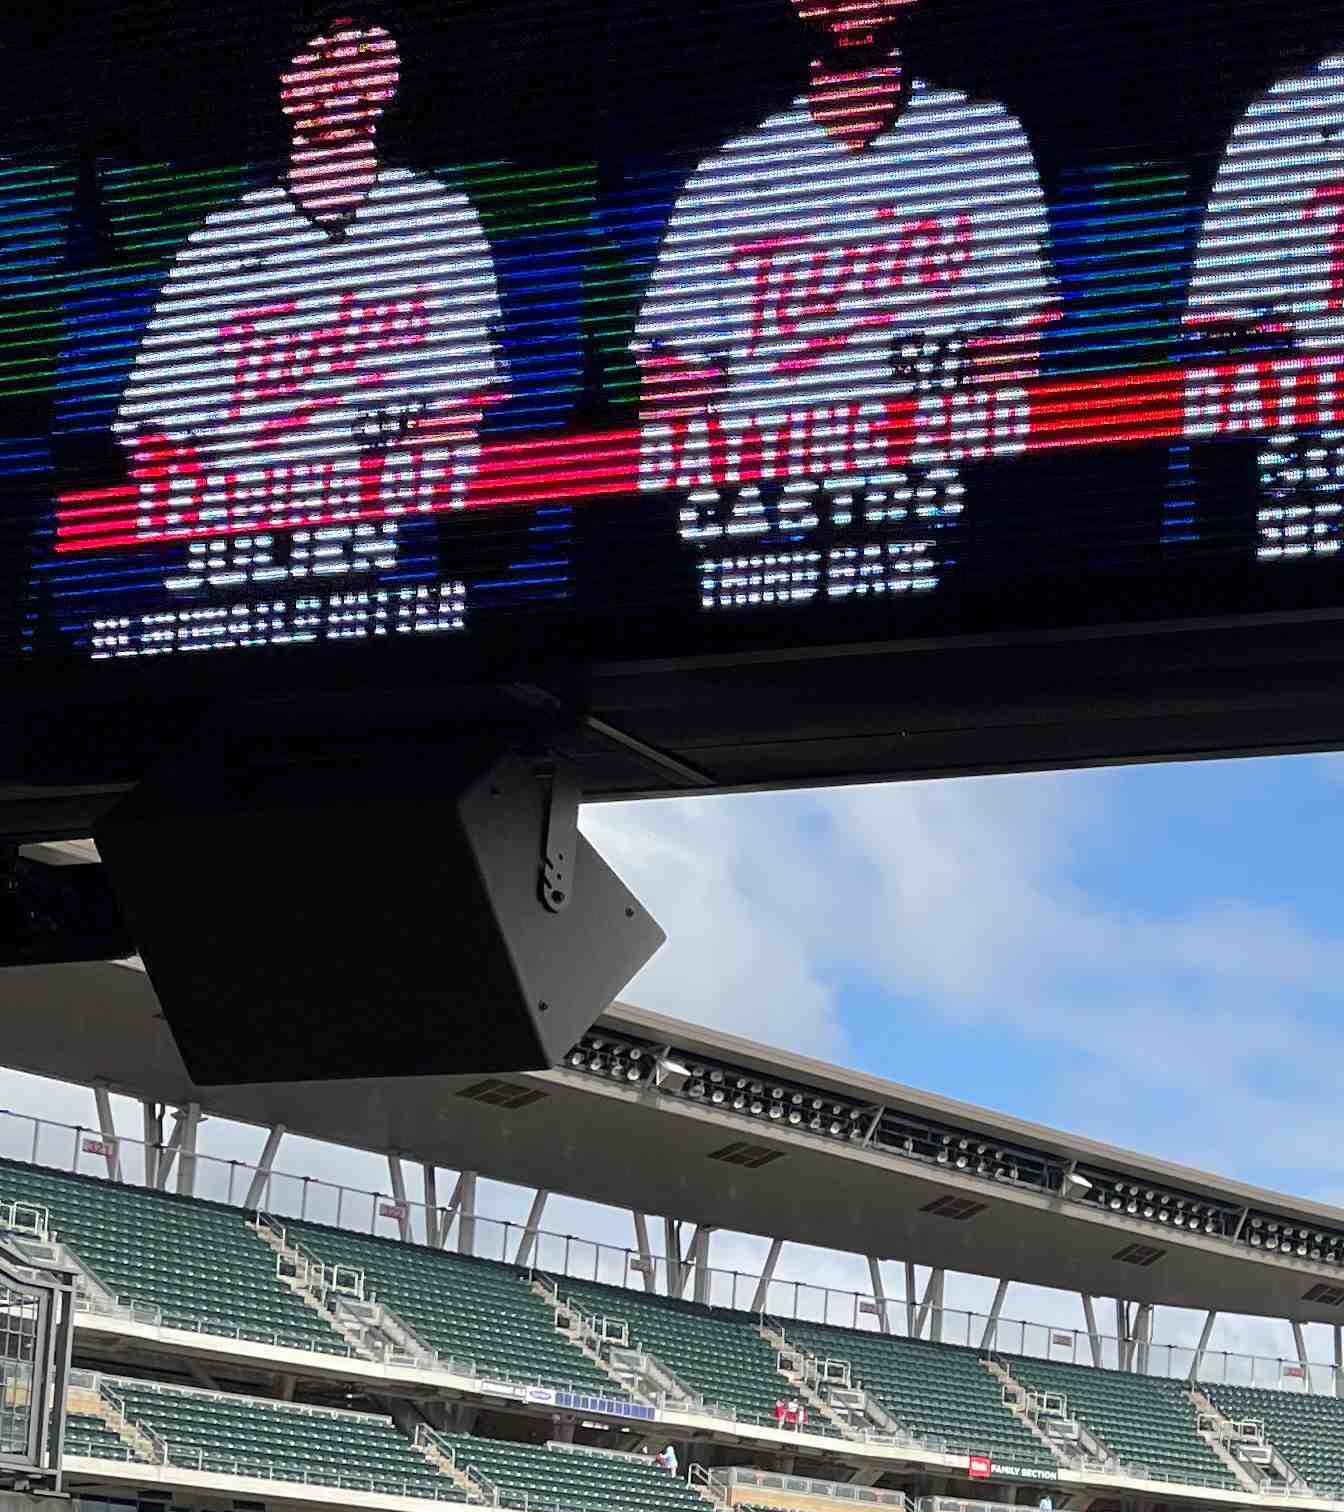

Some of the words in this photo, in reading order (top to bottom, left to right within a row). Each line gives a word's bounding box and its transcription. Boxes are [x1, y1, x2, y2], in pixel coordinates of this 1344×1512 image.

[679, 464, 966, 547] CASTRO
[166, 520, 398, 592] JULIEN
[991, 1463, 1020, 1475] FAMILY
[1020, 1468, 1058, 1480] SECTION
